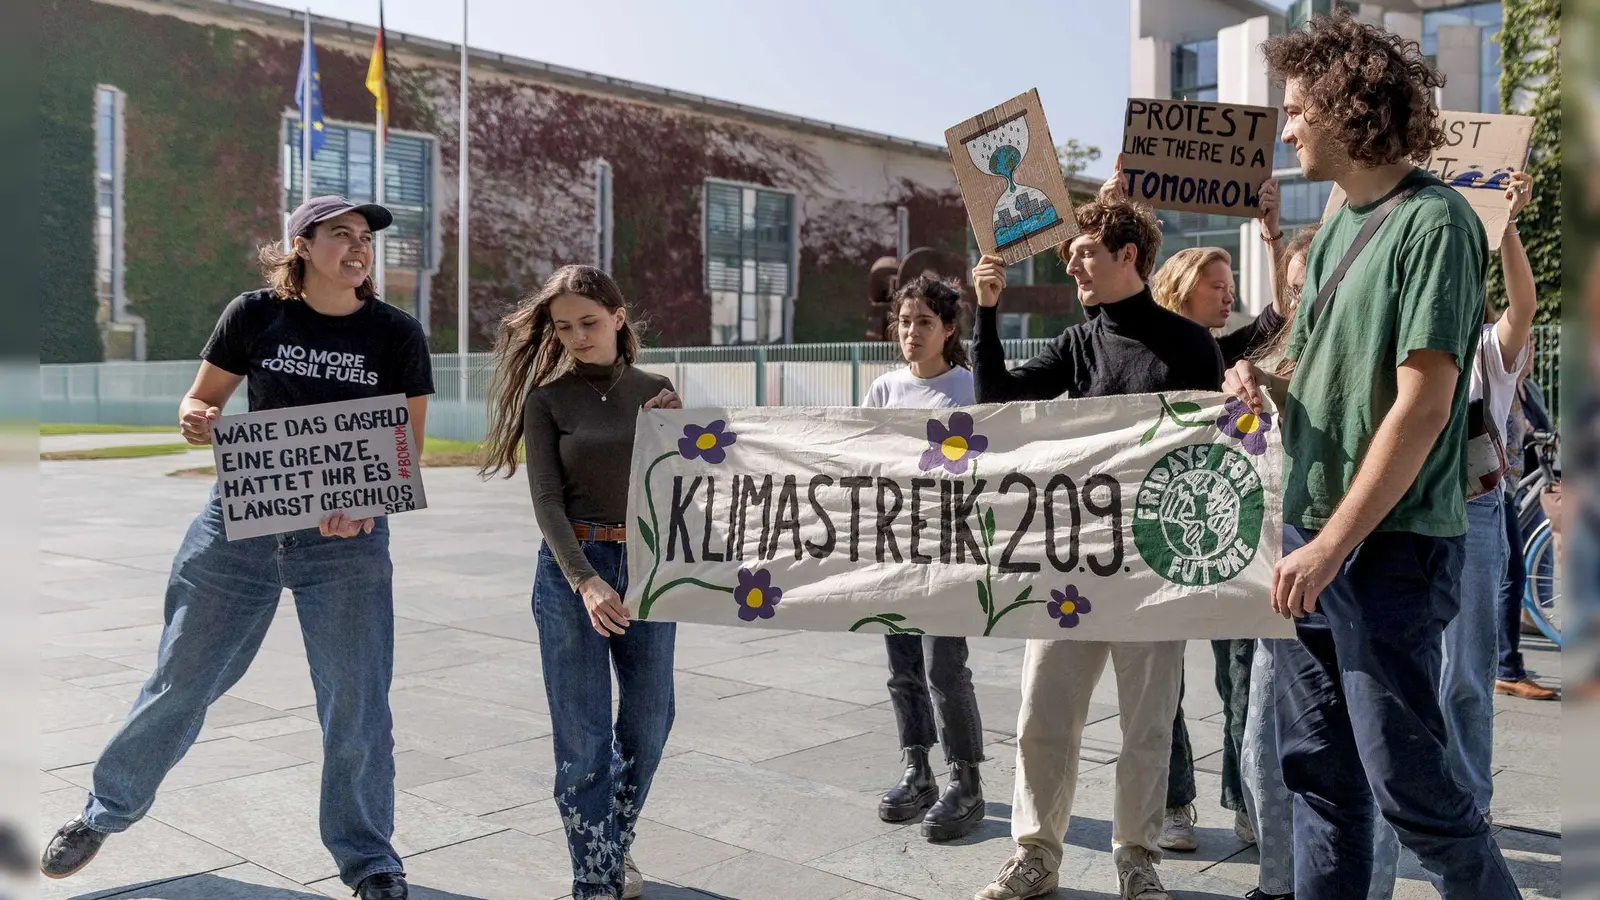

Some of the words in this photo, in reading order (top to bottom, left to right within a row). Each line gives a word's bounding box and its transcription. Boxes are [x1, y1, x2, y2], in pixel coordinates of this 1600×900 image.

[1126, 101, 1267, 142] PROTEST
[1122, 134, 1158, 156] LIKE
[1162, 137, 1225, 163] THERE
[1230, 145, 1246, 167] IS
[1250, 147, 1266, 168] A
[1122, 168, 1261, 208] TOMORROW
[261, 357, 322, 379] FOSSIL
[325, 366, 379, 386] FUELS
[277, 343, 305, 360] NO
[309, 349, 366, 369] MORE
[213, 421, 278, 446] WÄRE
[284, 415, 328, 437] DAS
[334, 406, 409, 432] GASFELD
[221, 449, 275, 473] EINE
[280, 439, 380, 468] GRENZE,
[224, 470, 314, 498] HÄTTET
[322, 466, 357, 487] IHR
[364, 462, 392, 483] ES
[1137, 445, 1209, 520] FRIDAYS
[1216, 451, 1260, 498] FOR
[227, 494, 315, 522] LÄNGST
[320, 484, 414, 511] GESCHLOS
[384, 501, 416, 515] SEN
[665, 473, 987, 565] KLIMASTREIK
[997, 472, 1131, 577] 20.9.
[1167, 537, 1254, 585] FUTURE
